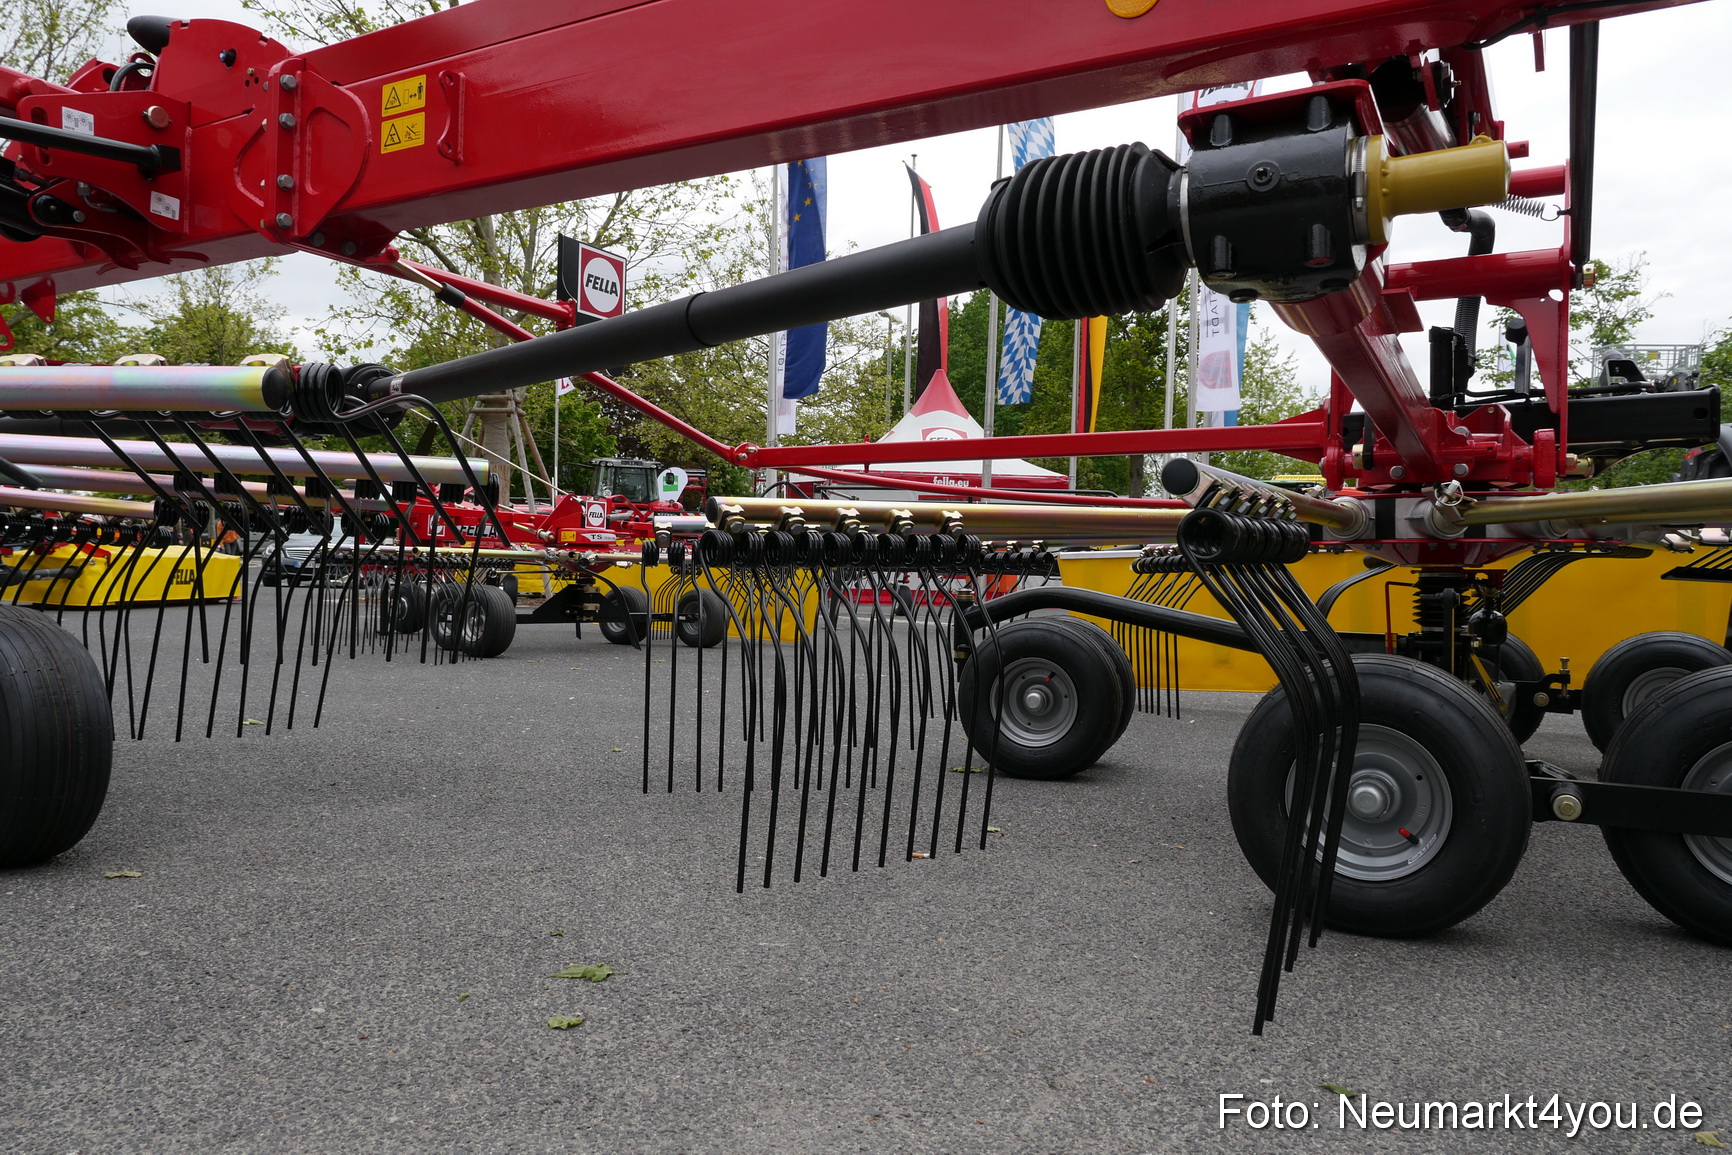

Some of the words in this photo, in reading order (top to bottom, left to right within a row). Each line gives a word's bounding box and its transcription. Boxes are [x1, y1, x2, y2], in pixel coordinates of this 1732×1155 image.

[585, 273, 619, 298] FELLA
[933, 476, 969, 487] fella.eu
[589, 511, 603, 519] FELLA
